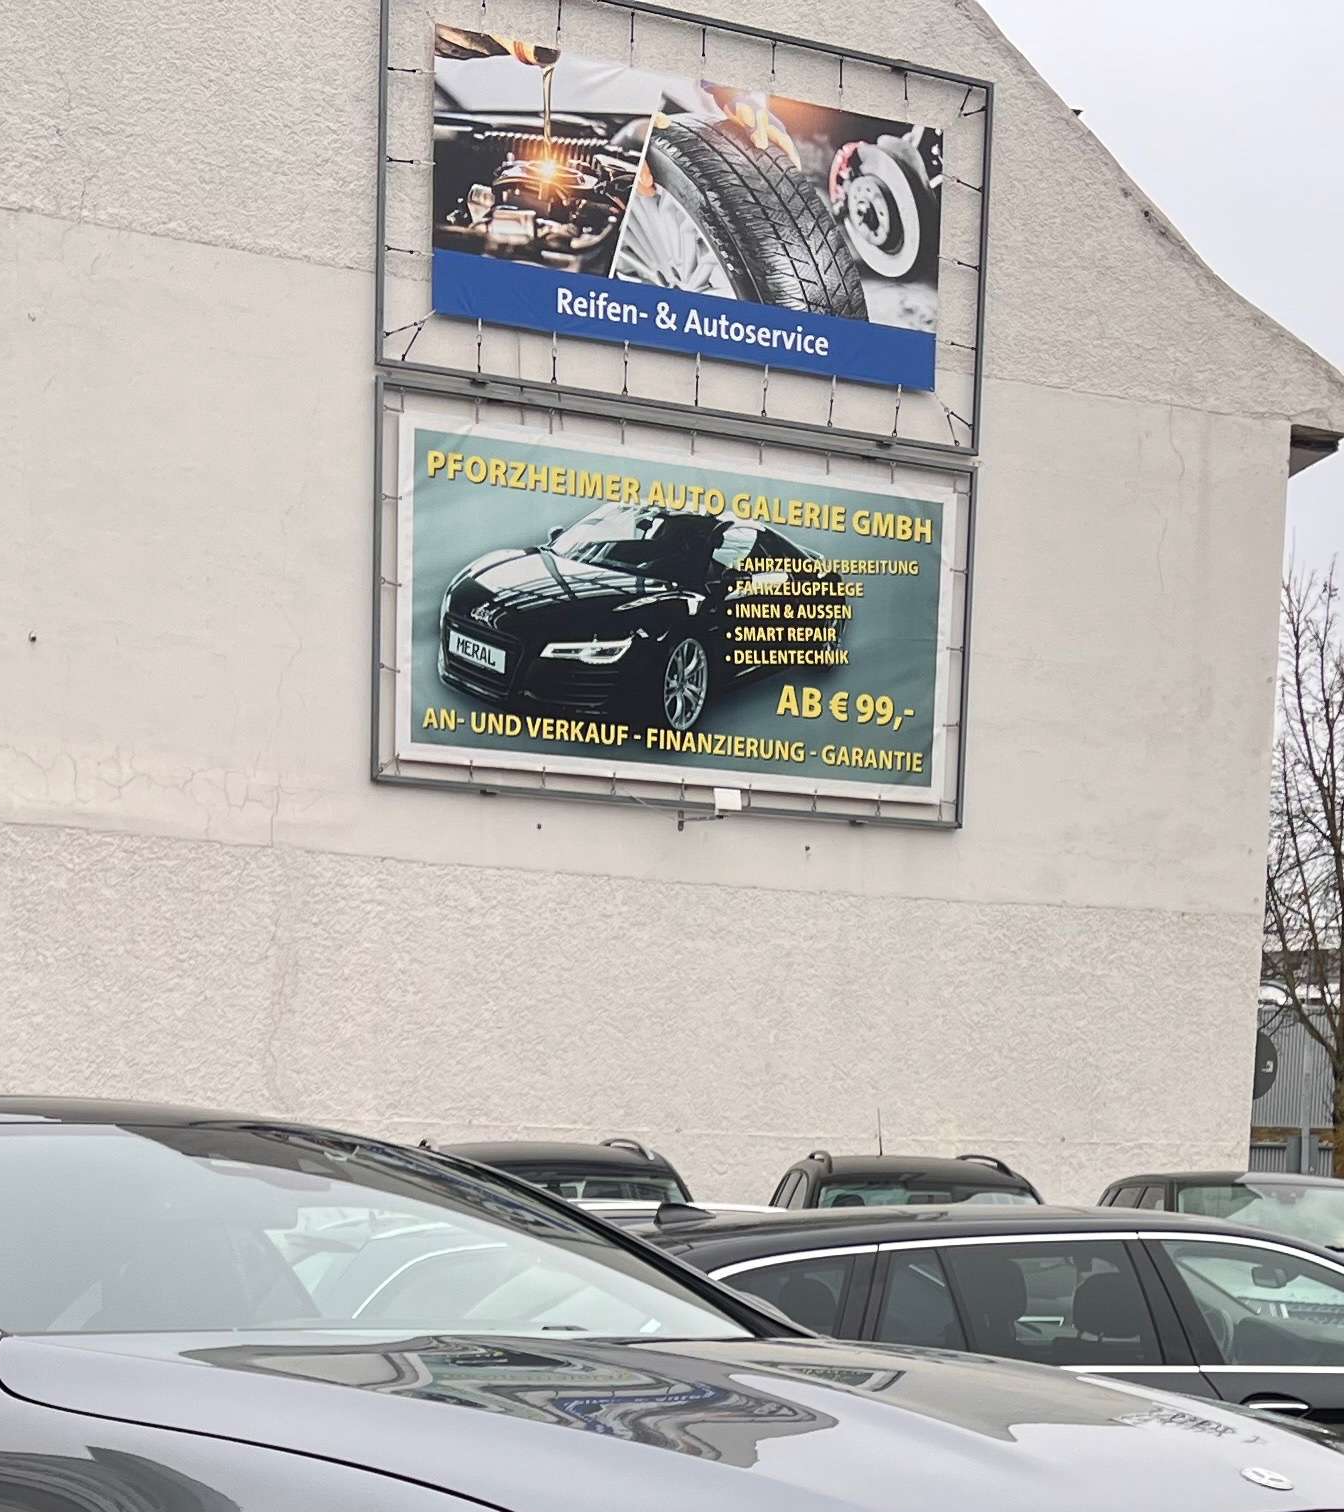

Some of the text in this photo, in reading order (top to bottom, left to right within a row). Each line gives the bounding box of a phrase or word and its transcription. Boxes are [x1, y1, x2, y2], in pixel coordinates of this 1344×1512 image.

[556, 287, 829, 357] Reifen- & Autoservice
[427, 450, 933, 544] PFORZHEIMER AUTO GALERIE GMBH
[738, 557, 919, 577] FAHRZEUGAUFBEREITUNG
[735, 581, 864, 598] FAHRZEUGPFLEGE
[735, 604, 852, 620] INNEN & AUSSEN
[734, 627, 837, 643] SMART REPAIR
[456, 637, 497, 667] MERAL
[734, 649, 849, 665] DELLENTECHNIK
[776, 684, 915, 731] AB € 99,-
[423, 707, 465, 731] AN-
[471, 711, 522, 737] UND
[527, 717, 630, 747] VERKAUF
[646, 727, 805, 763] FINANZIERUNG
[822, 745, 924, 773] GARANTIE
